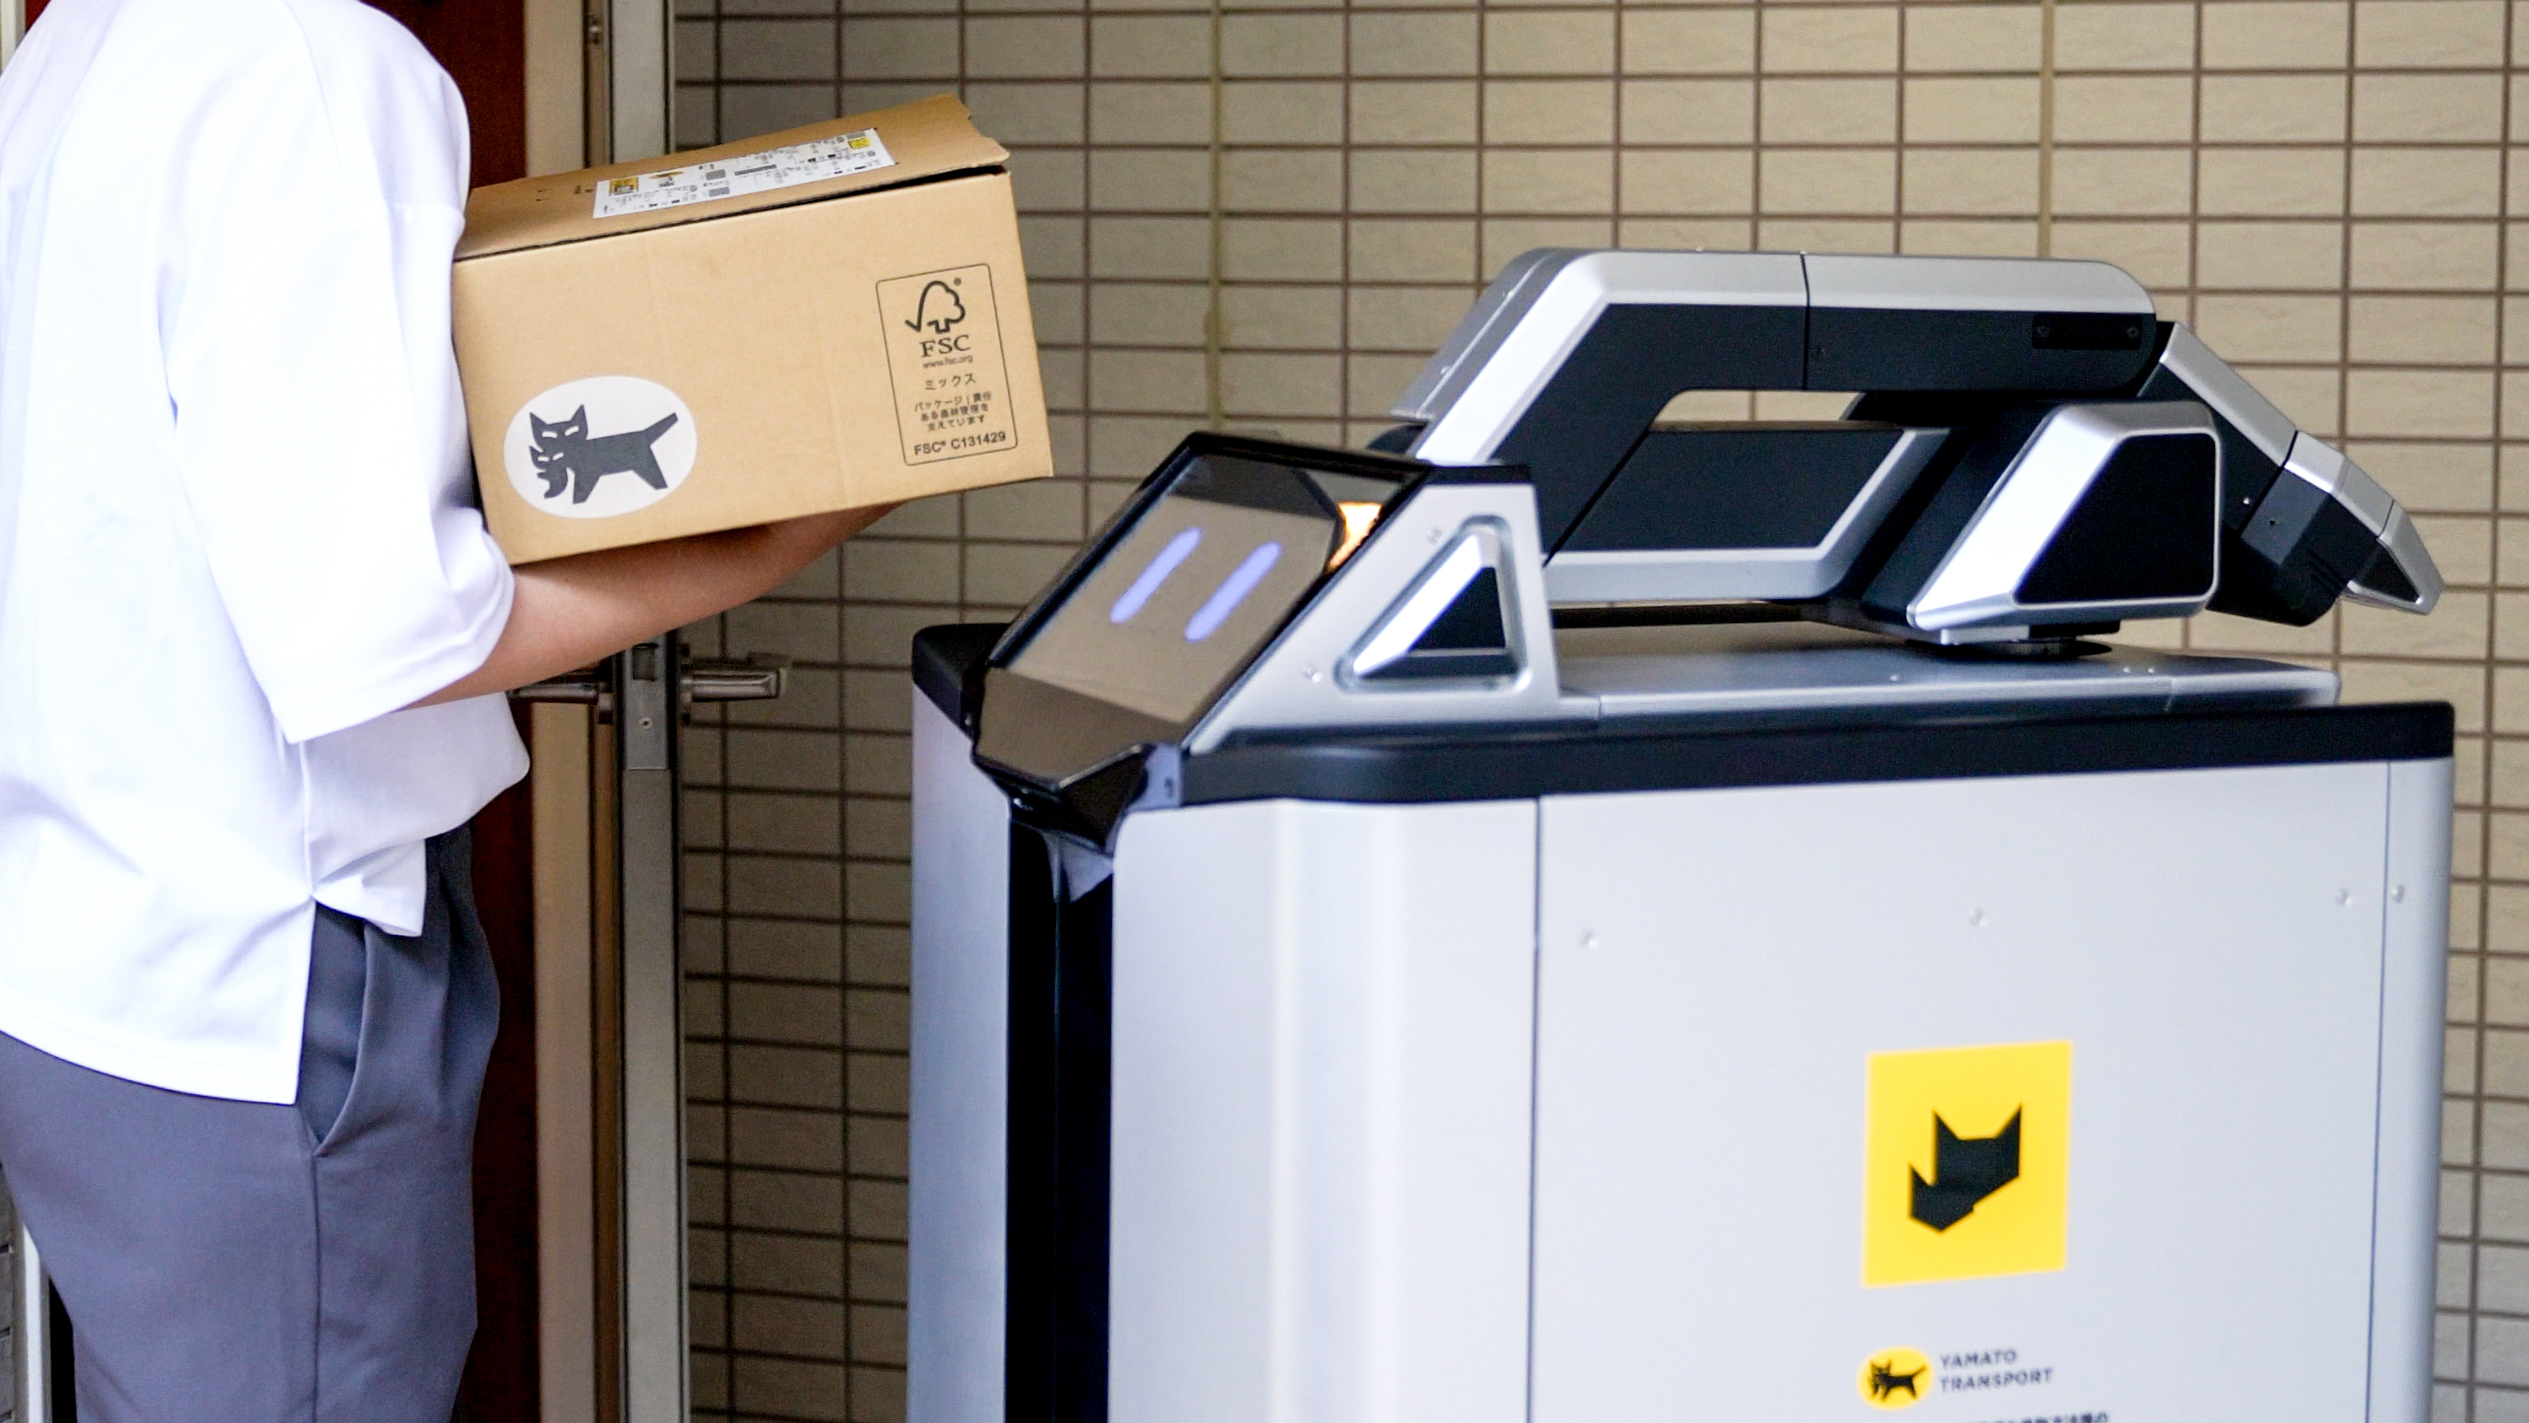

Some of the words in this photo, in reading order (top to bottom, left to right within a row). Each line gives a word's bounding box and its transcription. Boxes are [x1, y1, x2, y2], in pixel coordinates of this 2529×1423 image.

[919, 334, 971, 358] FSC
[922, 355, 974, 369] www.fsc.org
[925, 373, 976, 391] ミックス
[951, 431, 1006, 450] C131429
[1940, 1349, 2017, 1369] YAMATO
[1940, 1367, 2054, 1391] TRANSPORT
